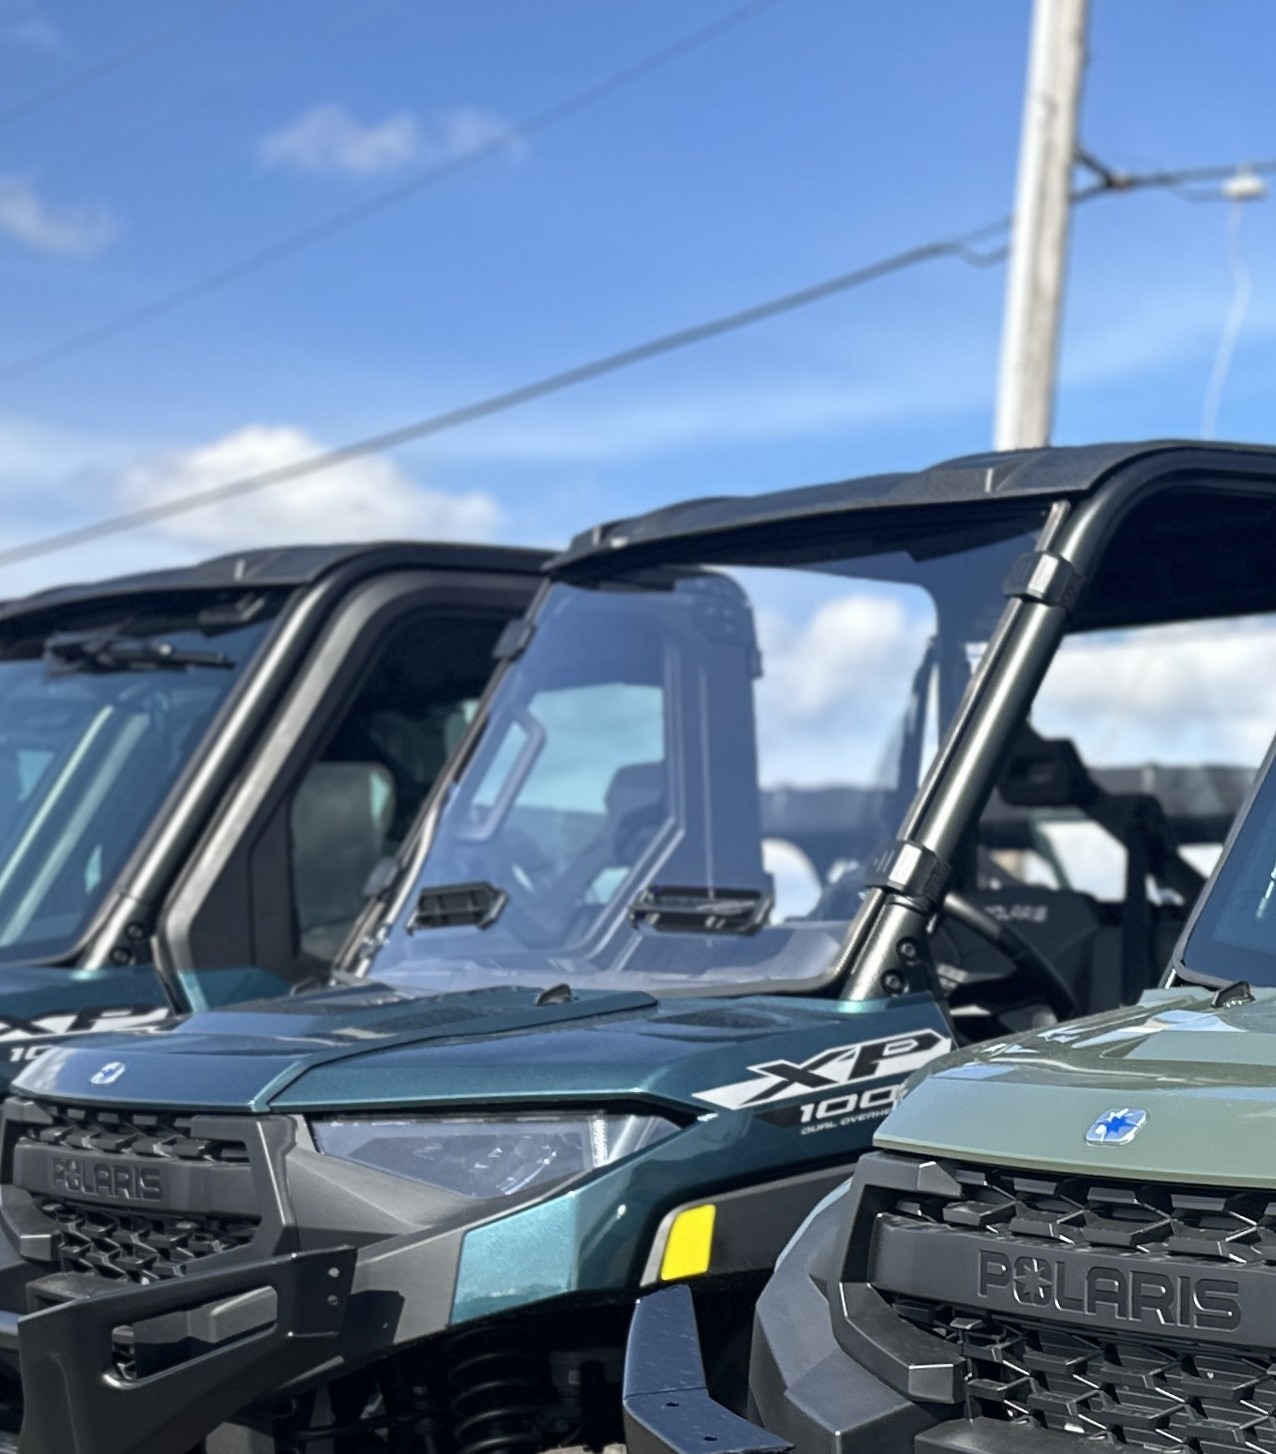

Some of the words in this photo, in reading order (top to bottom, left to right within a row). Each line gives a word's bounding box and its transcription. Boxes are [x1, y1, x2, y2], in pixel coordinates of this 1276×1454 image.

[738, 1029, 943, 1106] XP
[801, 1084, 904, 1123] 100
[801, 1121, 837, 1135] DUAL
[53, 1158, 162, 1201] POLARIS
[978, 1249, 1242, 1331] POLARIS
